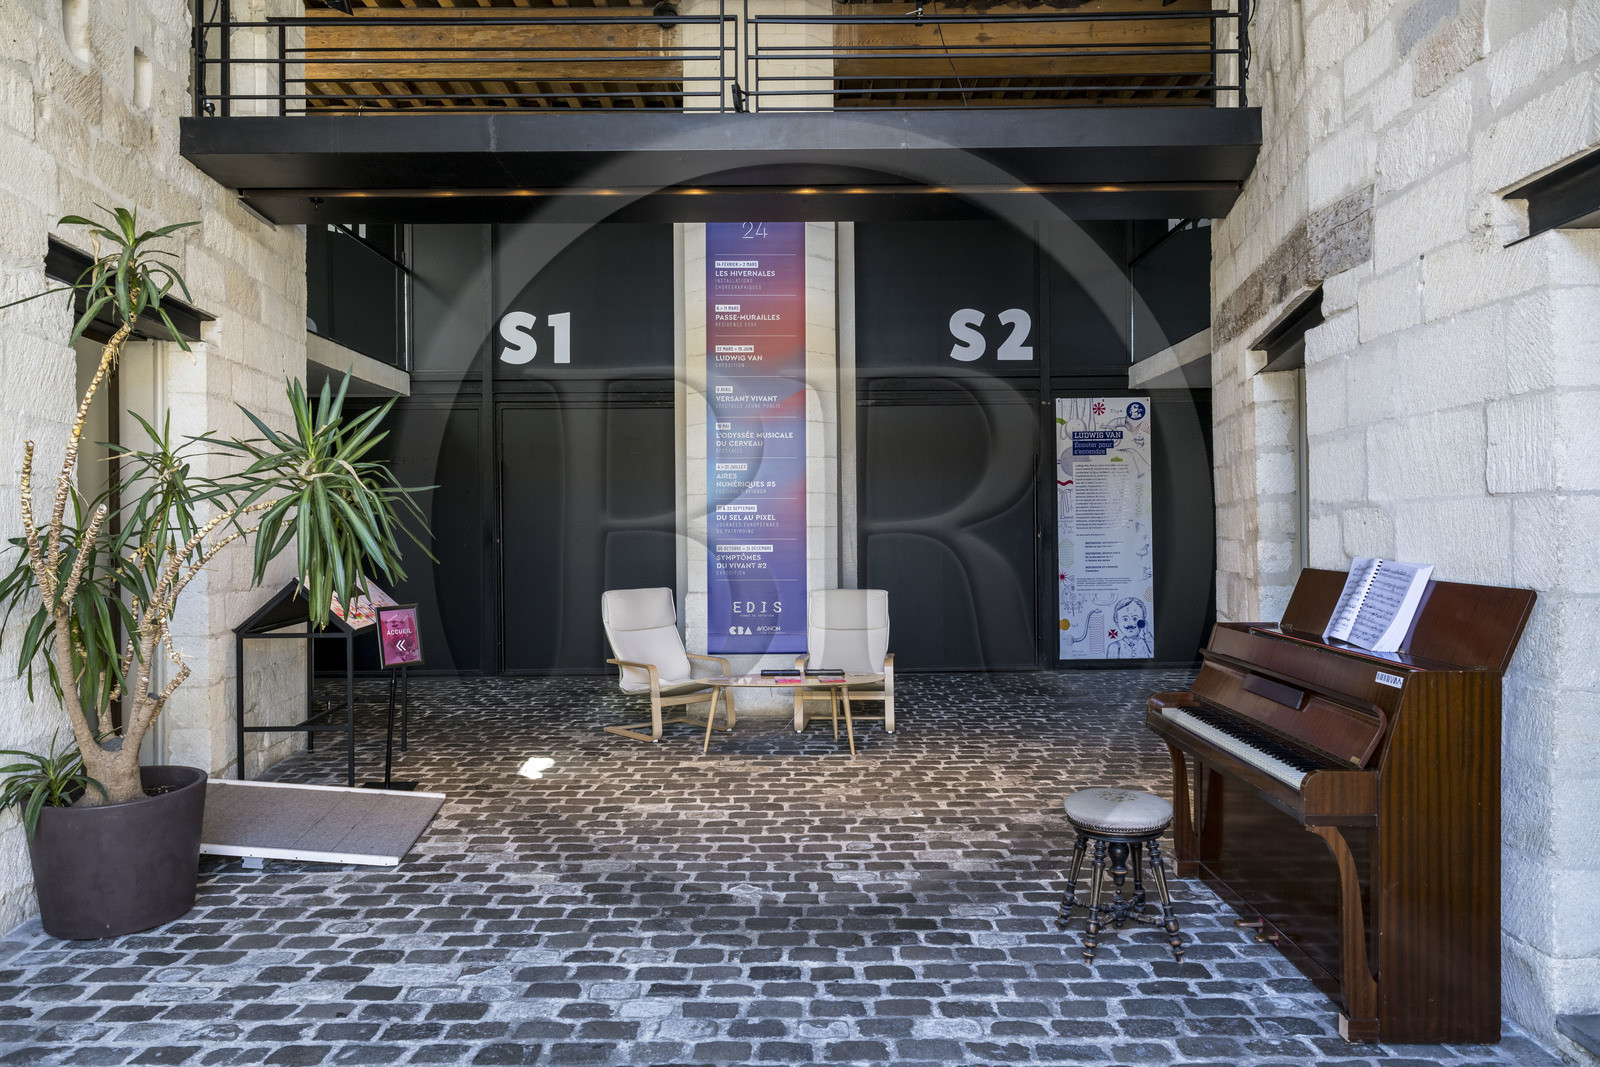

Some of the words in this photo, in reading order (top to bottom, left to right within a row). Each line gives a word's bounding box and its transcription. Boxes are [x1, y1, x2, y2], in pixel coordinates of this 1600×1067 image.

[742, 222, 768, 238] 24
[500, 311, 570, 364] S1
[949, 308, 1033, 361] S2
[716, 480, 764, 488] NUMÉRIQUES
[733, 602, 782, 613] EDIS
[729, 626, 752, 635] CBA
